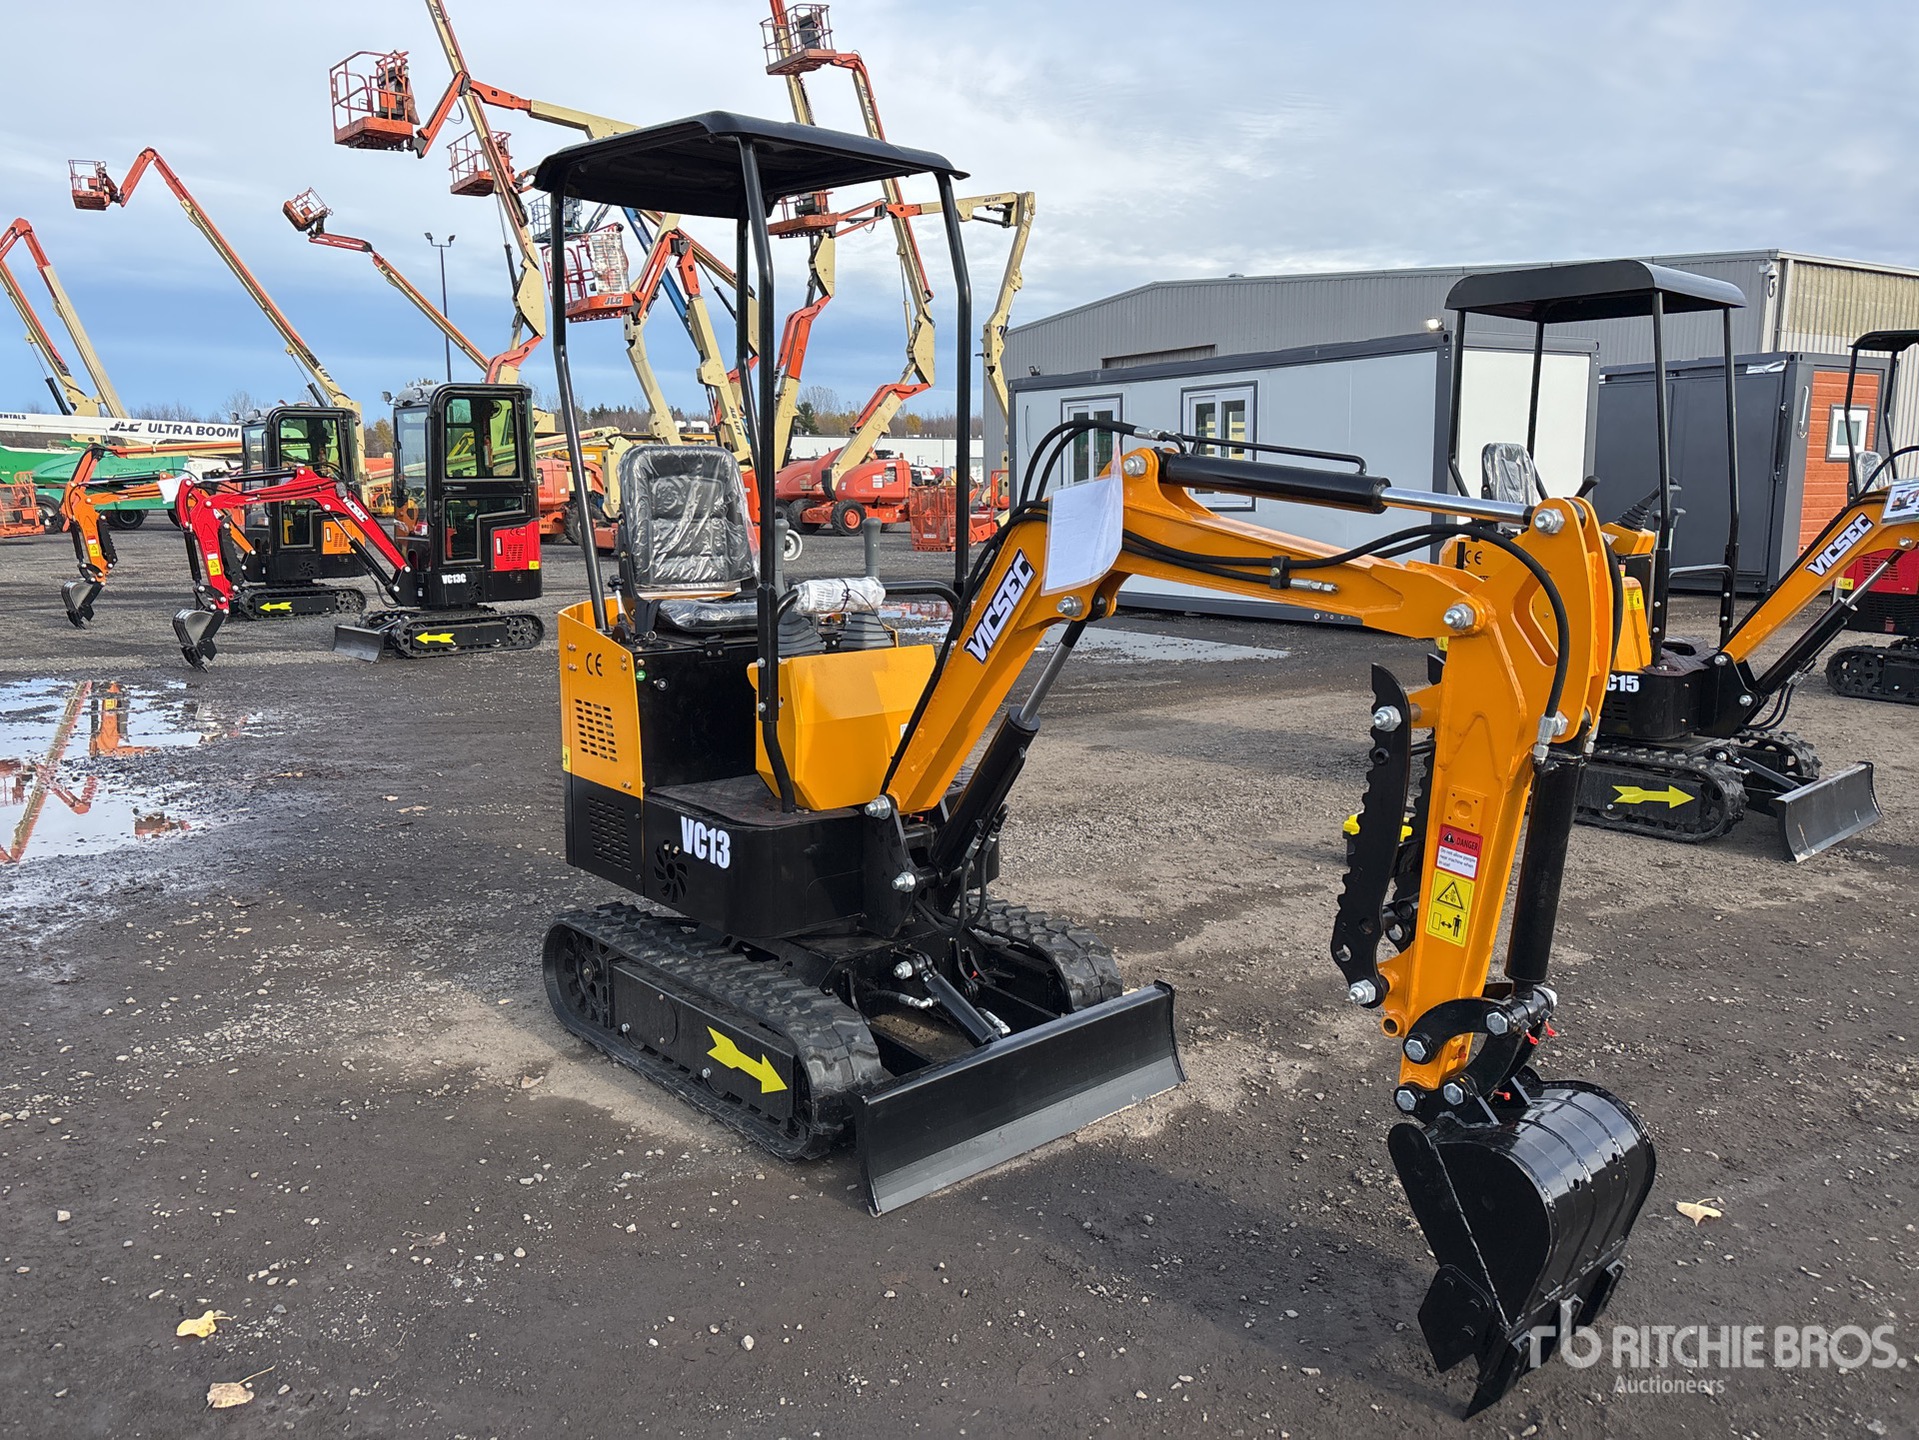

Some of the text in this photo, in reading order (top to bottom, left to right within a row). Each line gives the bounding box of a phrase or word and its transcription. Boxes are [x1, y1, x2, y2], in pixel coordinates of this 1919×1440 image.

[605, 296, 623, 305] JLG
[147, 423, 193, 435] ULTRA
[195, 424, 239, 438] BOOM
[734, 421, 742, 436] LIFT
[1804, 512, 1875, 577] VICSEC
[1465, 550, 1483, 565] CE
[441, 573, 467, 584] VC13C
[963, 548, 1037, 664] VICSEC
[585, 652, 603, 677] CE
[680, 815, 731, 869] VC13
[1456, 837, 1478, 851] DANGER
